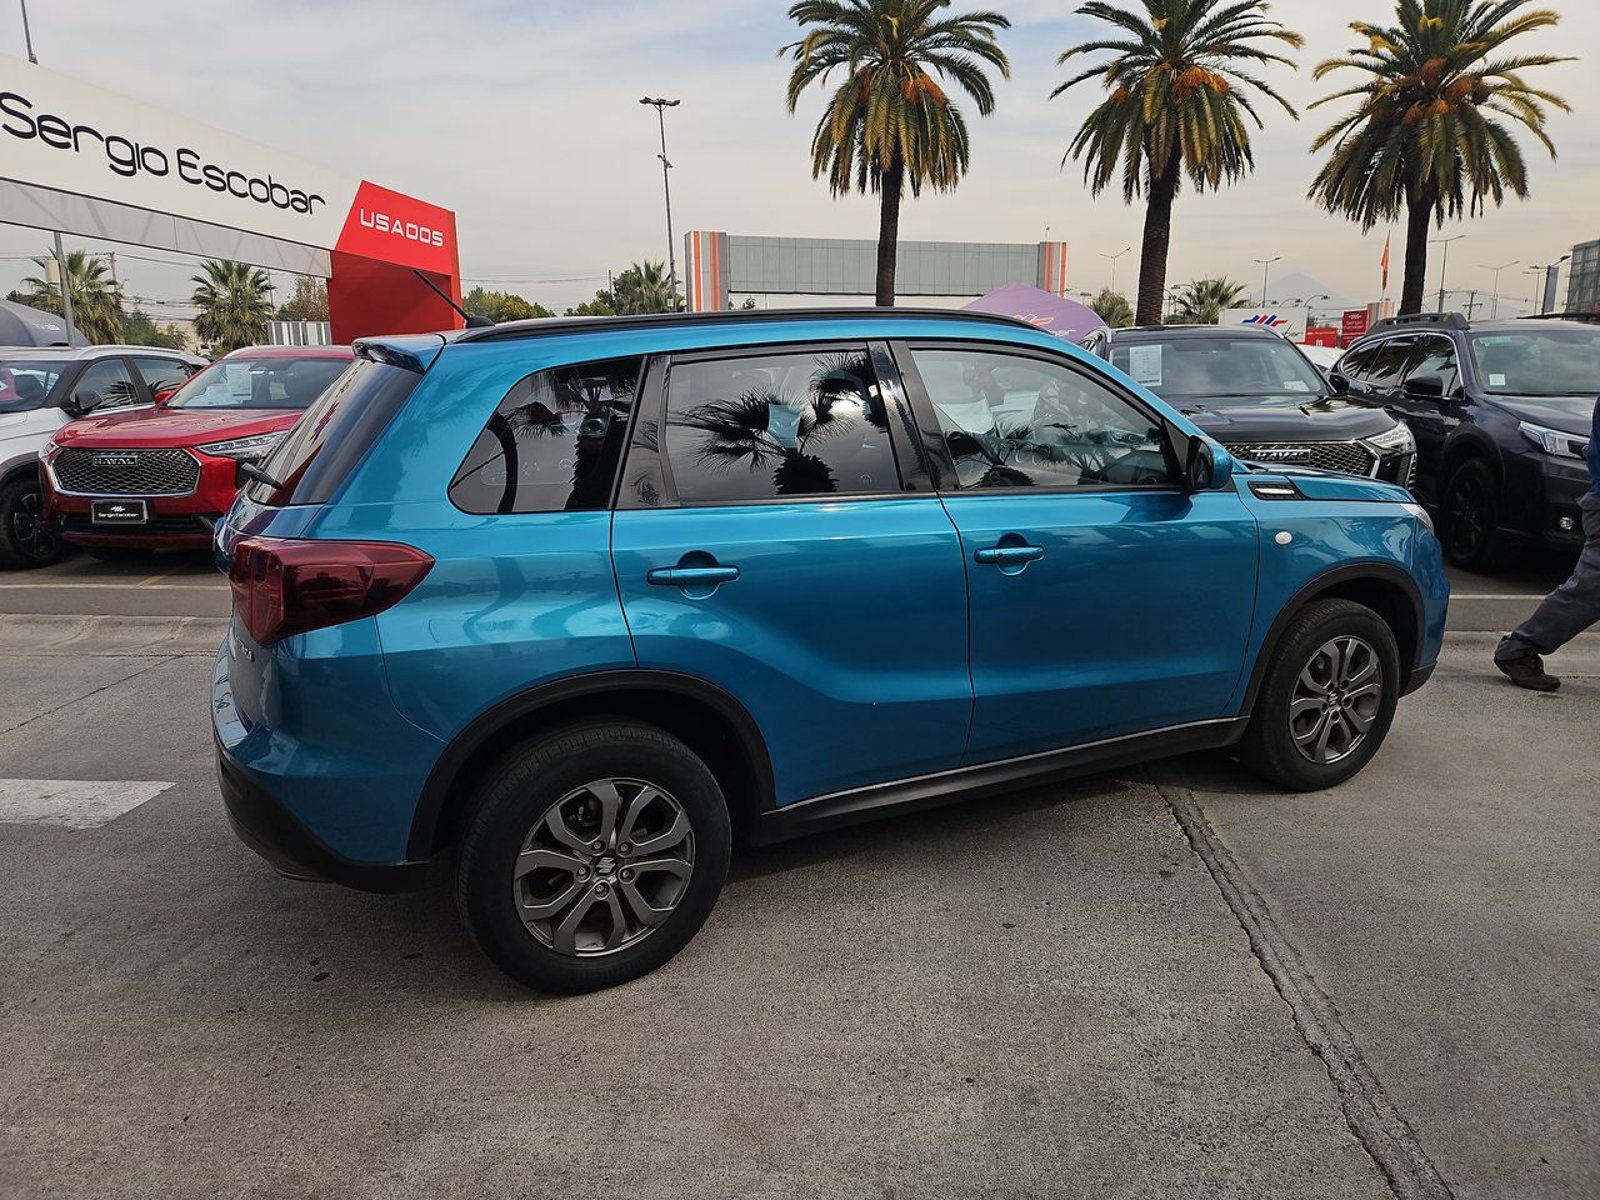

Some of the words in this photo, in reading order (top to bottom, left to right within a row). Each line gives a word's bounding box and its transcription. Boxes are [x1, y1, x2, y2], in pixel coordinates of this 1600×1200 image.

[0, 92, 169, 177] Sergio
[176, 147, 326, 214] Escobar
[359, 207, 445, 248] USADOS
